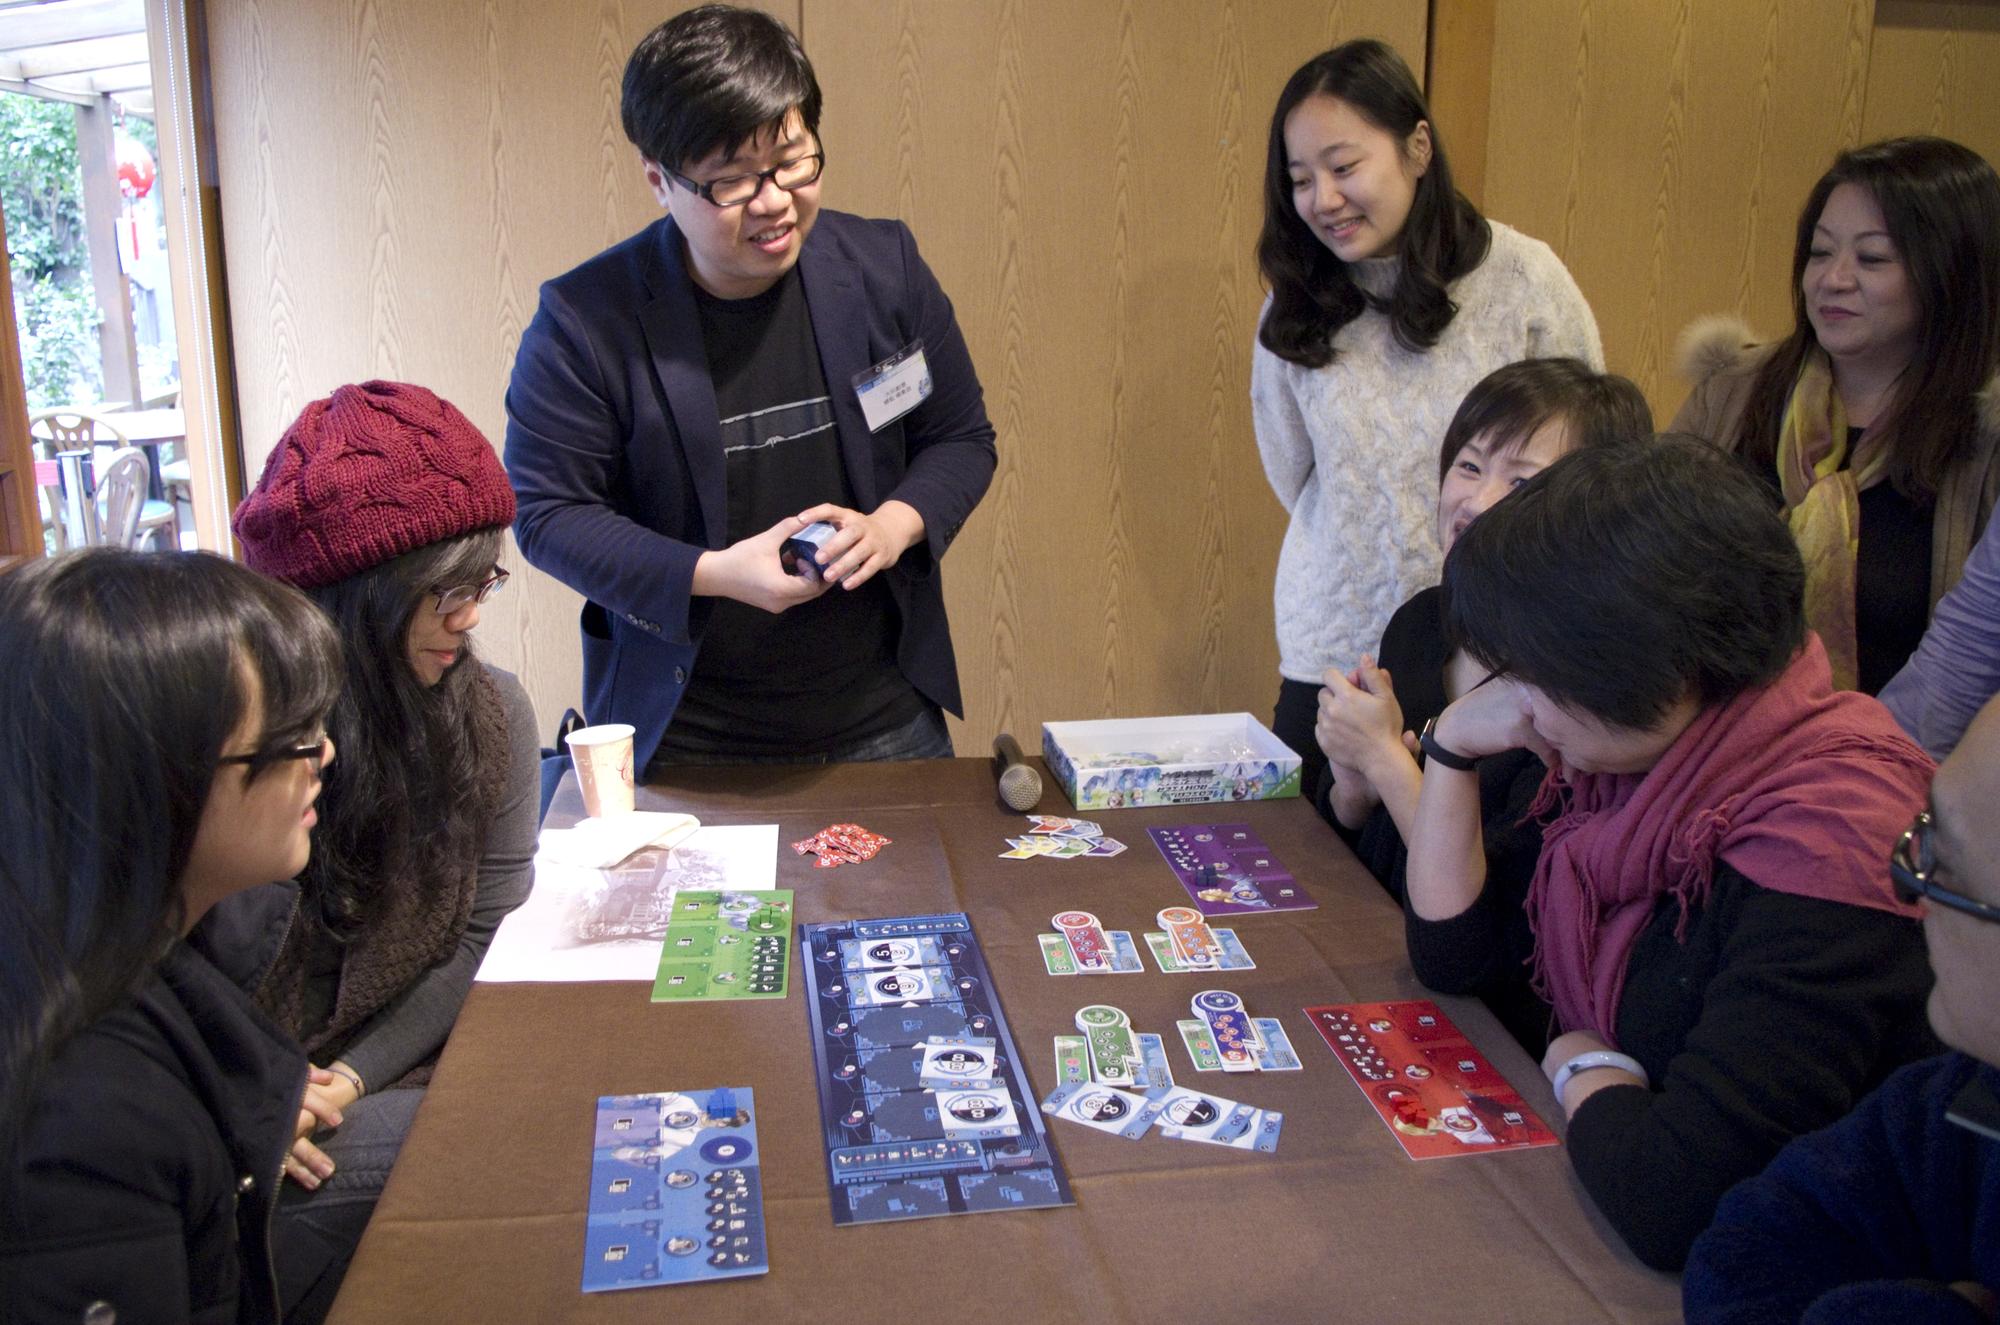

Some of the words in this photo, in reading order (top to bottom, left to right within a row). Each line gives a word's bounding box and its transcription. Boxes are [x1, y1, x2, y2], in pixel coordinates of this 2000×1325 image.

[883, 983, 898, 991] 6
[951, 1053, 965, 1062] 8
[970, 1108, 986, 1118] 8
[1102, 1104, 1119, 1115] 8
[1193, 1109, 1210, 1120] 7
